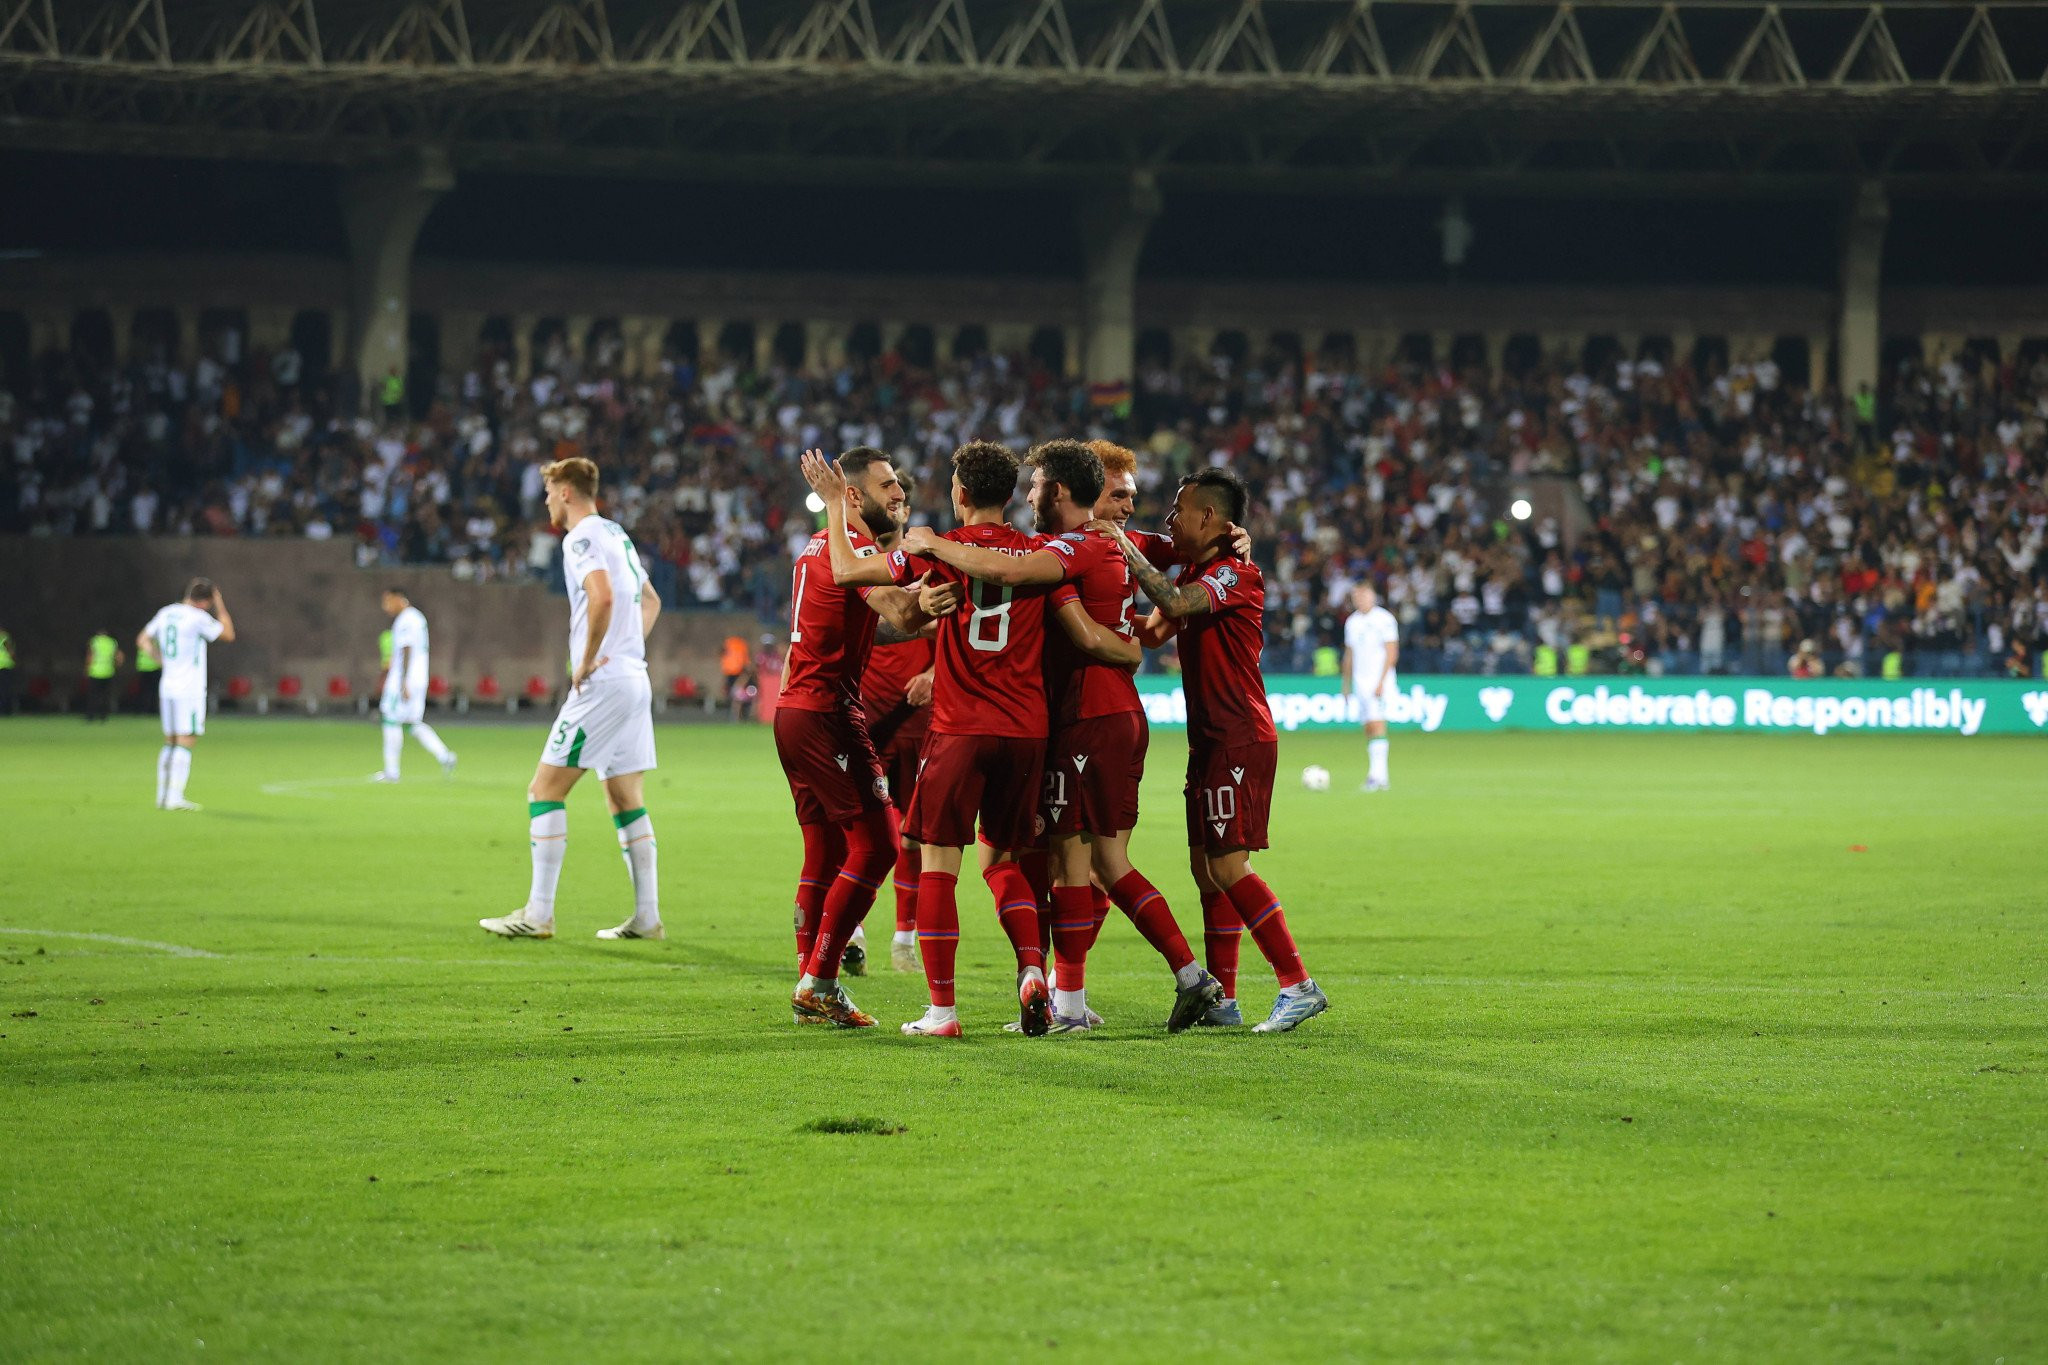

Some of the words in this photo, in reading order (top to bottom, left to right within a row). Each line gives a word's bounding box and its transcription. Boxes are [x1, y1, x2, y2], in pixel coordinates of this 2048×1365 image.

[968, 577, 1014, 652] 8
[1545, 684, 1738, 727] Celebrate
[1743, 687, 1987, 736] Responsibly
[554, 720, 571, 745] 5
[1045, 771, 1068, 806] 21
[1204, 785, 1235, 821] 10
